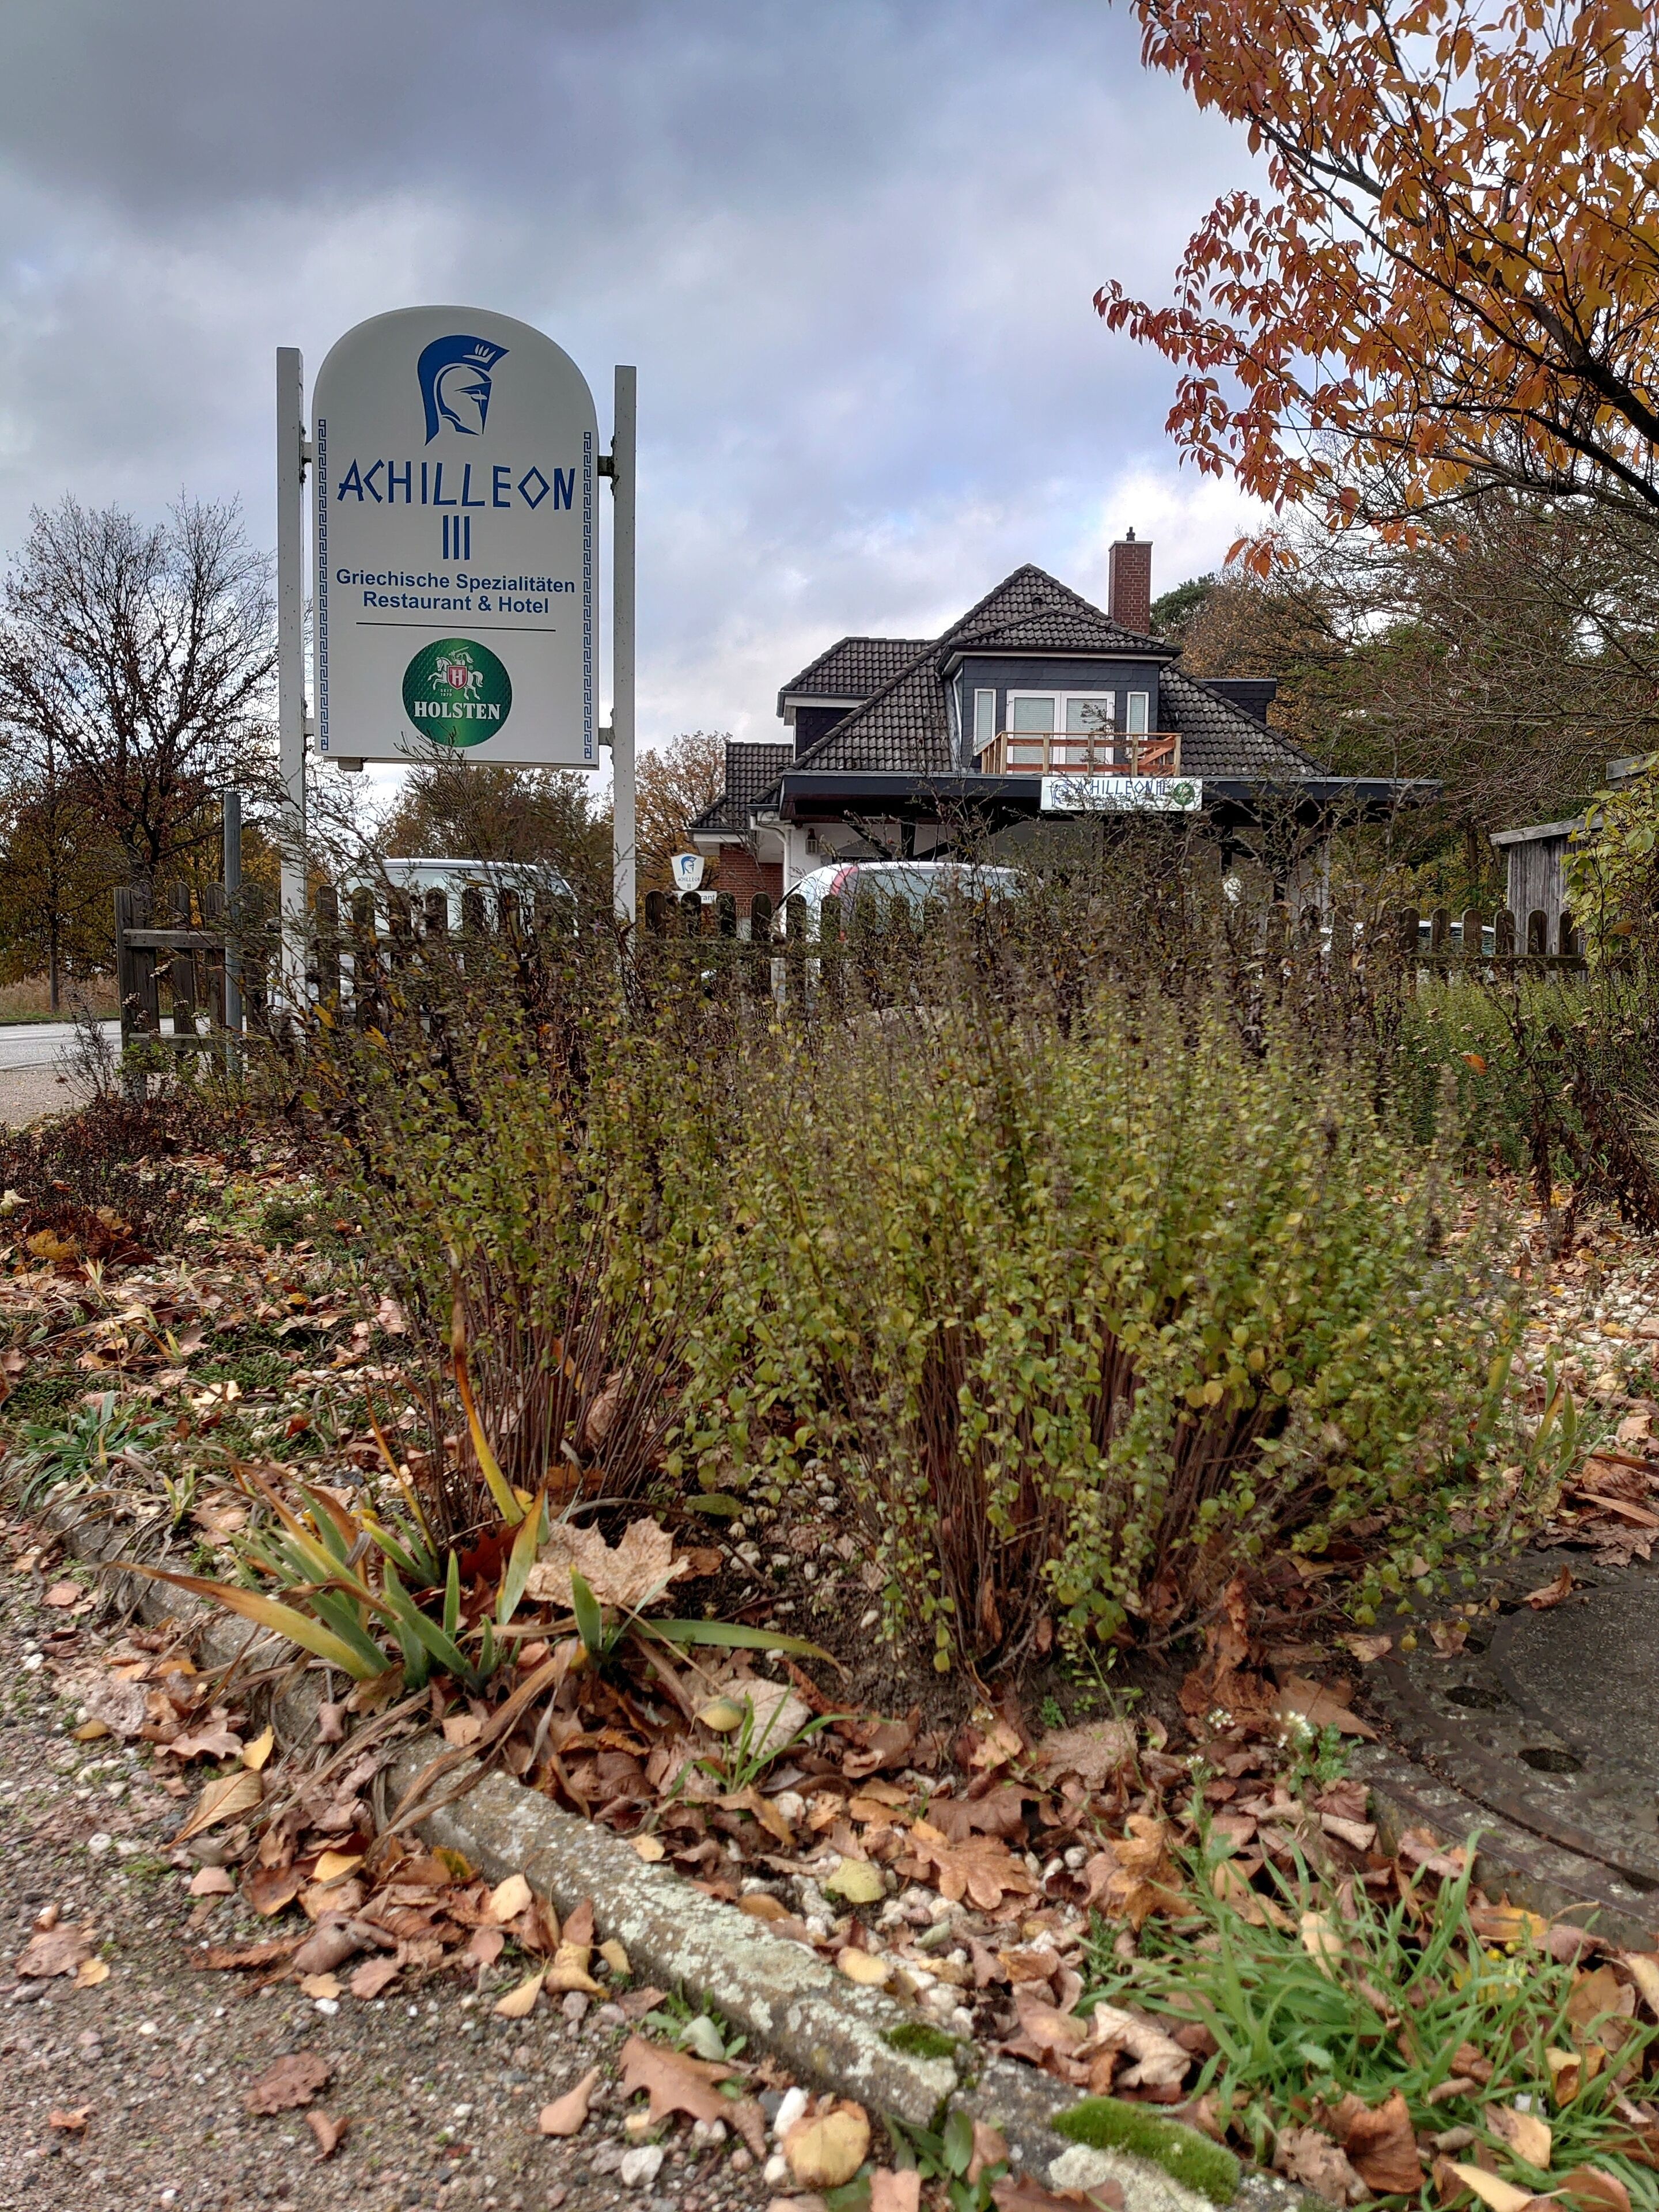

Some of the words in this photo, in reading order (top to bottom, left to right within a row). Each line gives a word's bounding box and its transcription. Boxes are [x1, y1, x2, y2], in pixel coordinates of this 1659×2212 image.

[337, 459, 575, 510] ACHILLEON
[442, 515, 471, 560] III
[336, 569, 450, 589] Griechische
[456, 573, 575, 593] Spezialitäten
[363, 591, 472, 611] Restaurant
[478, 596, 493, 612] &
[499, 596, 549, 613] Hotel
[451, 669, 463, 686] H
[414, 700, 501, 721] HOLSTEN
